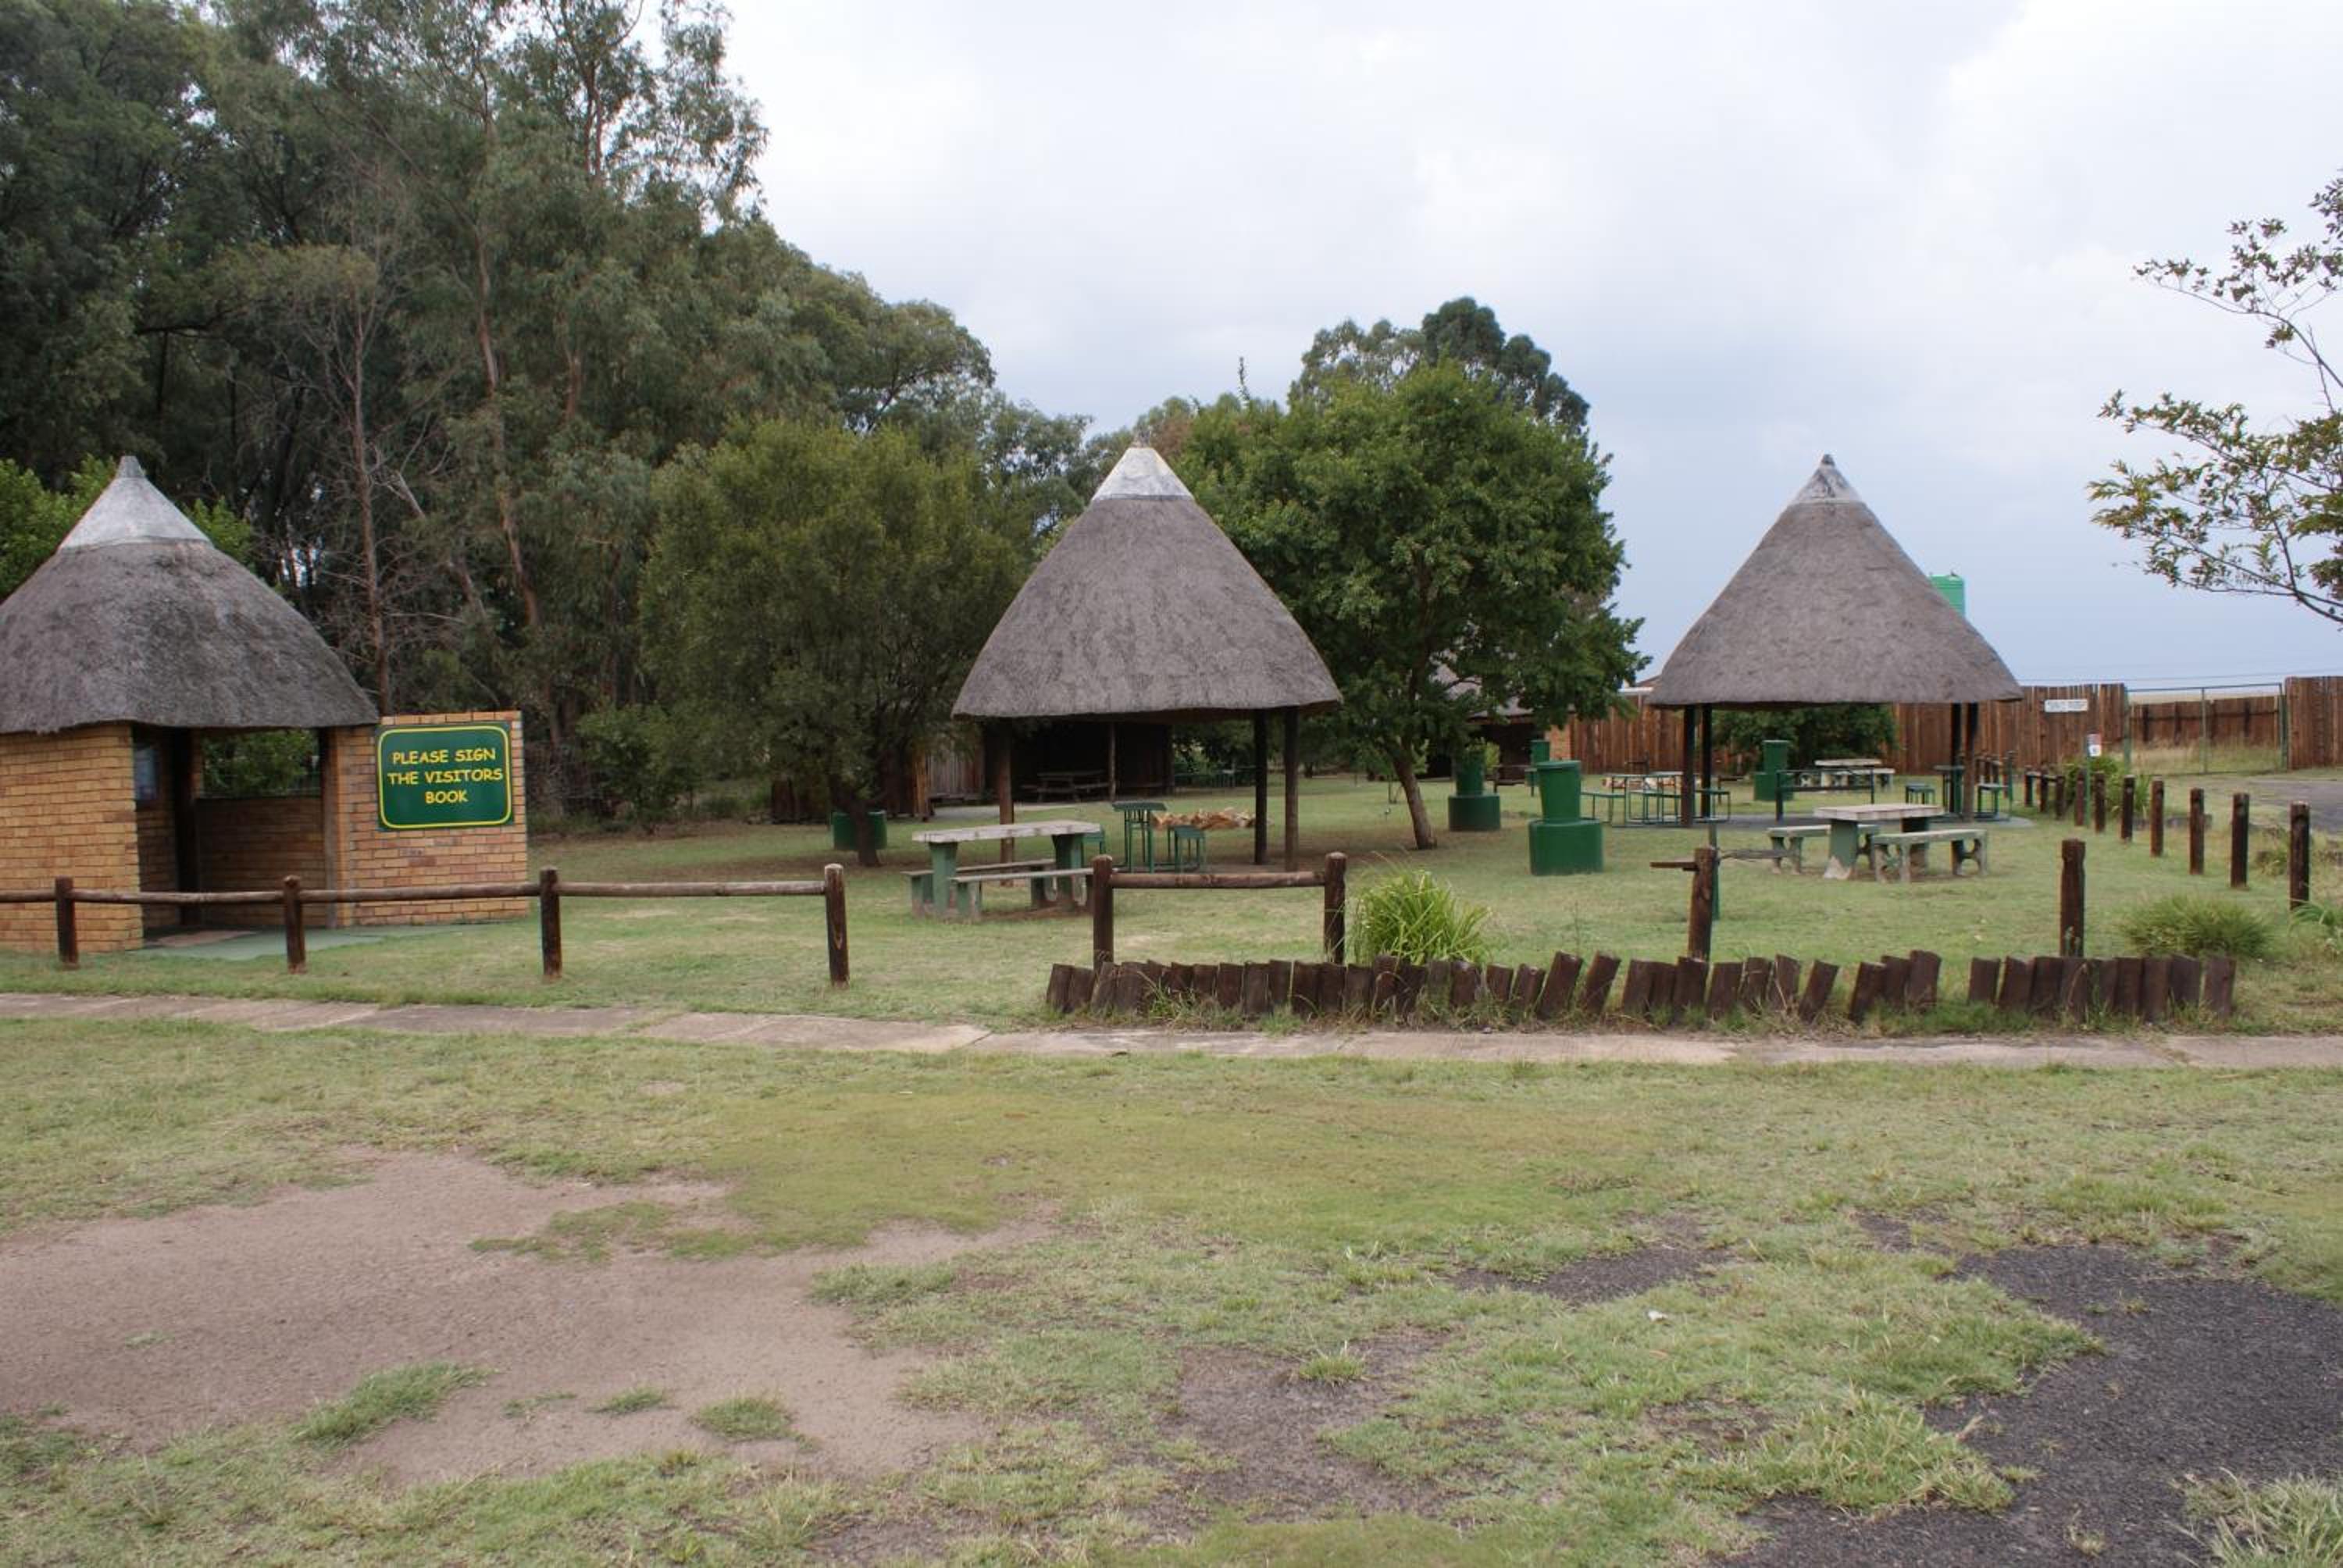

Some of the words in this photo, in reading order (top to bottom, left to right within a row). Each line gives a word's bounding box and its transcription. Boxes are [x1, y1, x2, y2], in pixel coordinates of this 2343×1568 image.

[392, 750, 449, 764] PLEASE
[455, 747, 496, 761] SIGN
[387, 771, 419, 785] THE
[425, 768, 503, 783] VISITORS
[426, 789, 469, 804] BOOK
